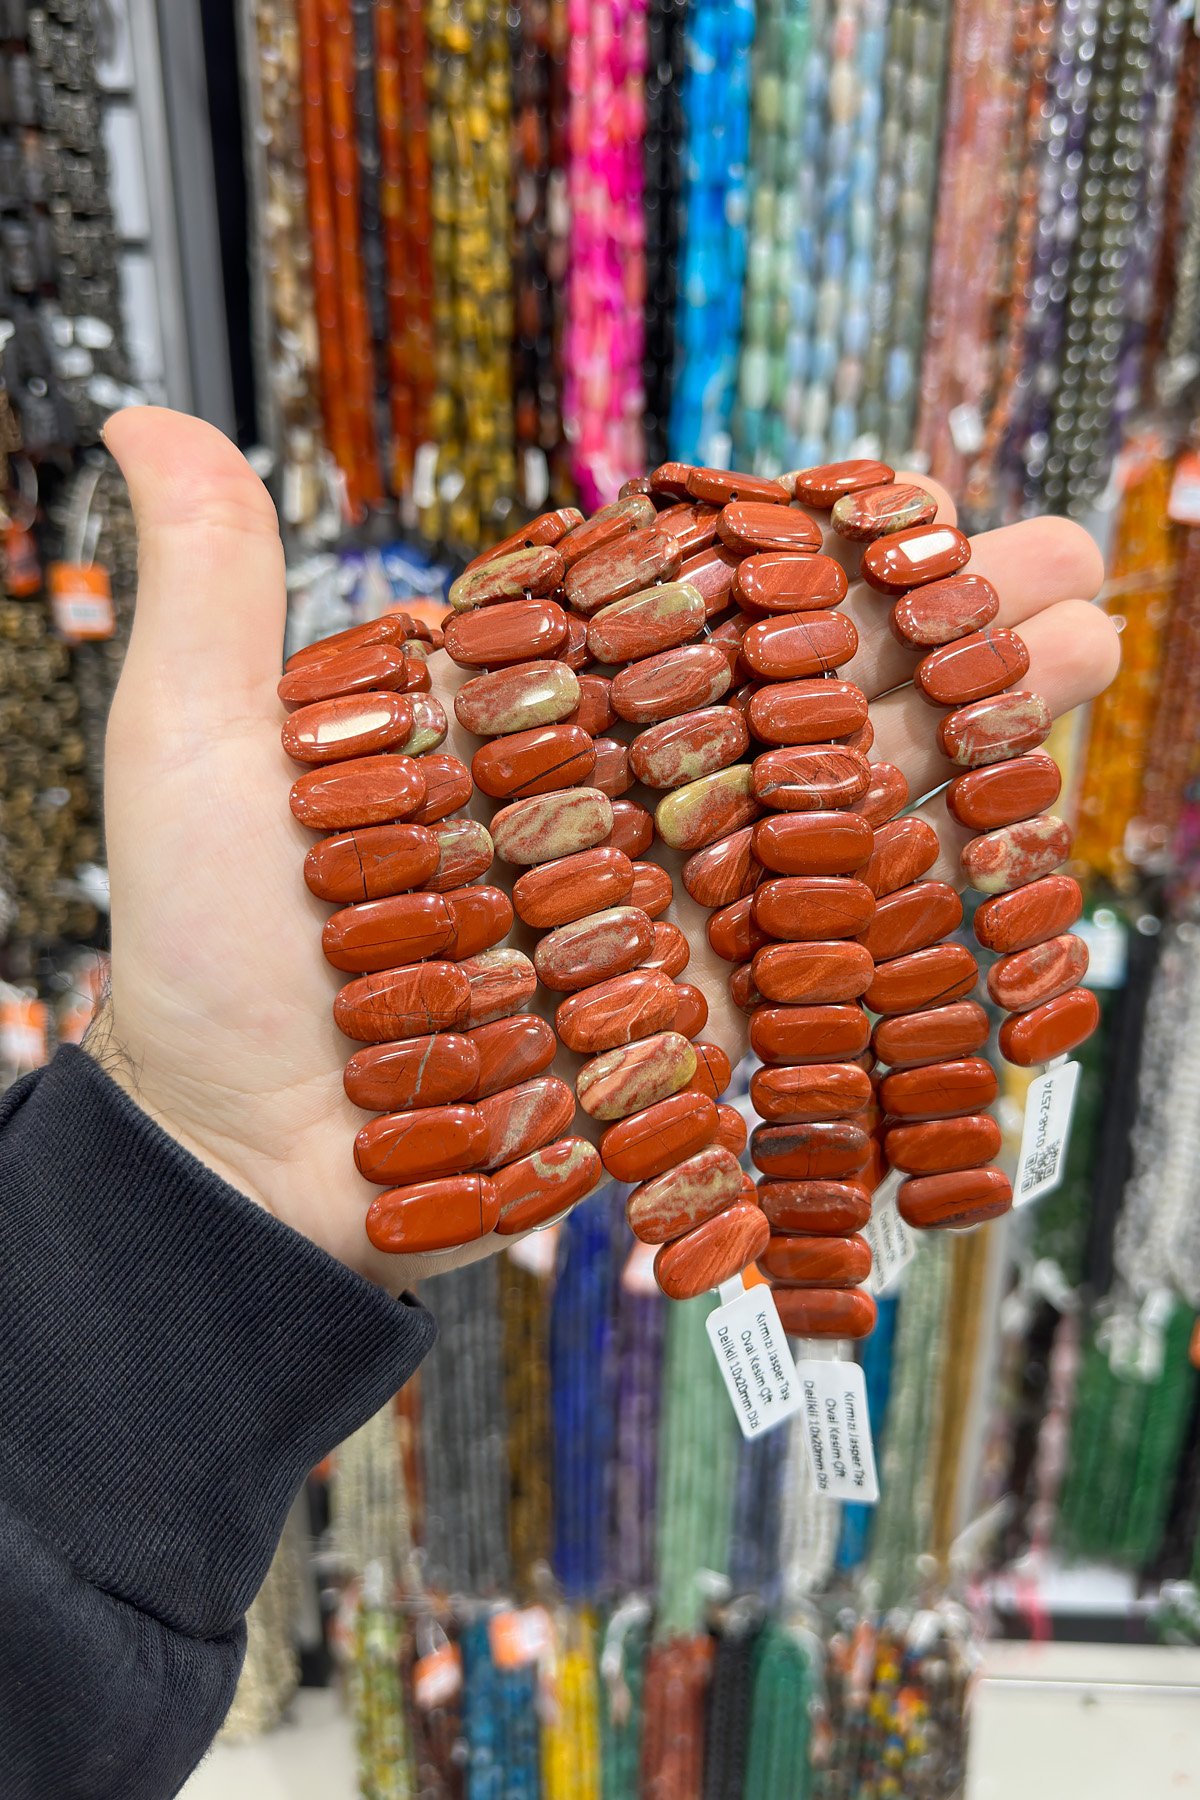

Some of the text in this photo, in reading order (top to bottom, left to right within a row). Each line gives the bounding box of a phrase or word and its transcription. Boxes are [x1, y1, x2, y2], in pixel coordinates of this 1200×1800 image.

[717, 1326, 739, 1362] Delikli
[730, 1361, 753, 1411] 10x20mm
[741, 1330, 755, 1355] Oval
[749, 1355, 765, 1387] Kesim
[768, 1349, 785, 1382] Jasper
[804, 1380, 820, 1418] Delikli
[825, 1398, 840, 1425] Oval
[829, 1426, 842, 1459] Kesim
[848, 1432, 863, 1470] Jasper
